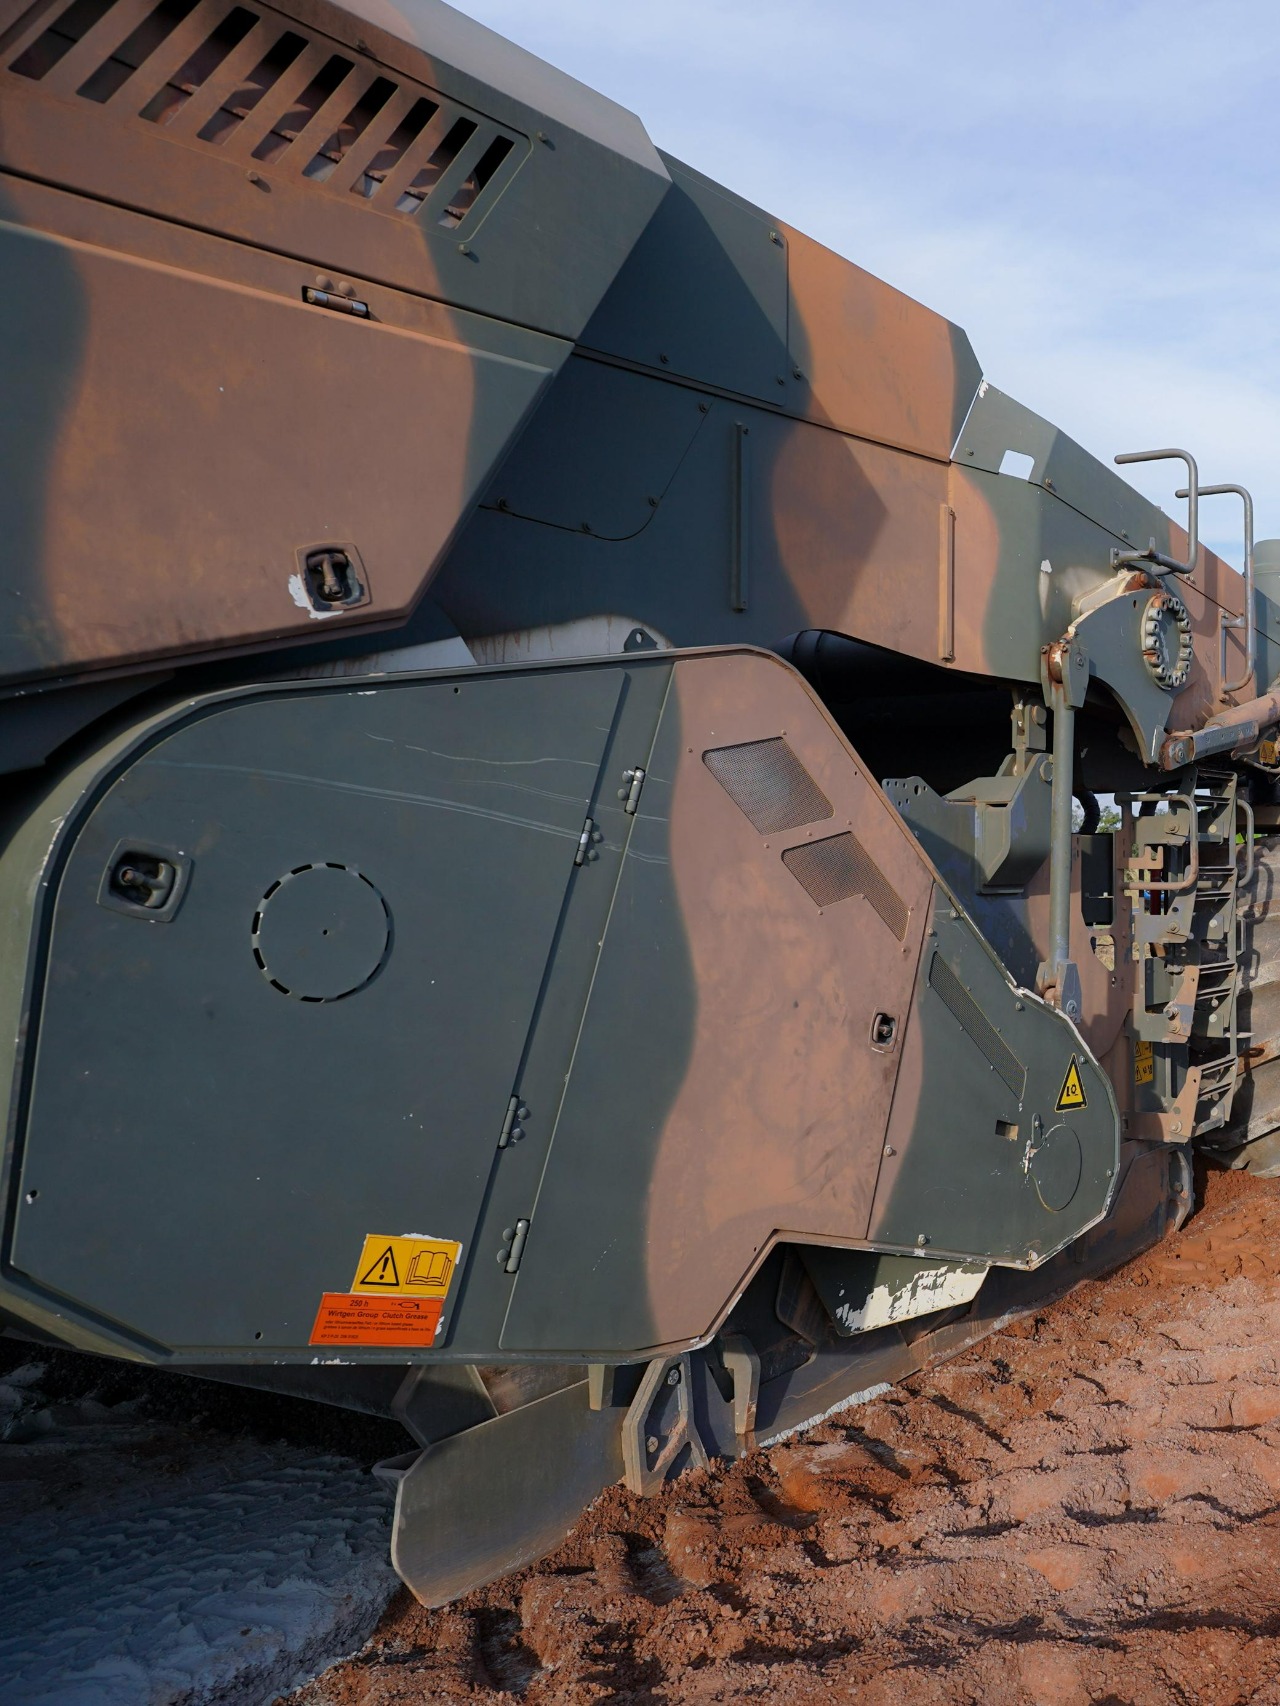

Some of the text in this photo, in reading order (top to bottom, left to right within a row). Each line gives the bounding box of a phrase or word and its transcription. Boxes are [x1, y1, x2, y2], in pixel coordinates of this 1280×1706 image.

[350, 1299, 369, 1307] 250 h
[328, 1310, 356, 1319] Wirtgen
[357, 1311, 379, 1320] Group
[382, 1312, 404, 1320] Clutch
